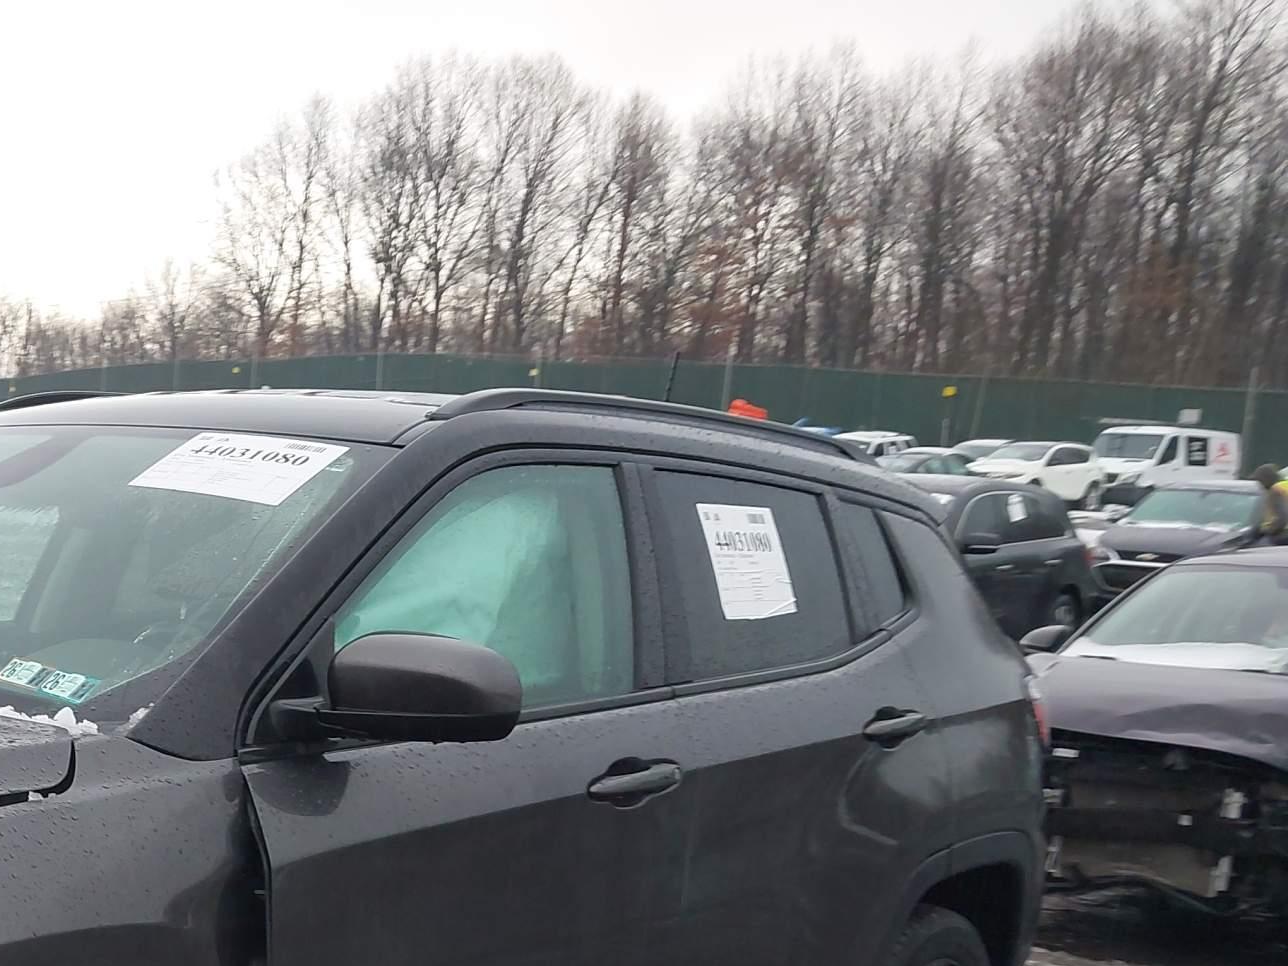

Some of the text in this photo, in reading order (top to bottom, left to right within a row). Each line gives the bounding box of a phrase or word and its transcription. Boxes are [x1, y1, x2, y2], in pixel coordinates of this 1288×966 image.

[190, 444, 310, 466] 44031080
[715, 531, 772, 552] 44031080
[43, 673, 66, 690] 26
